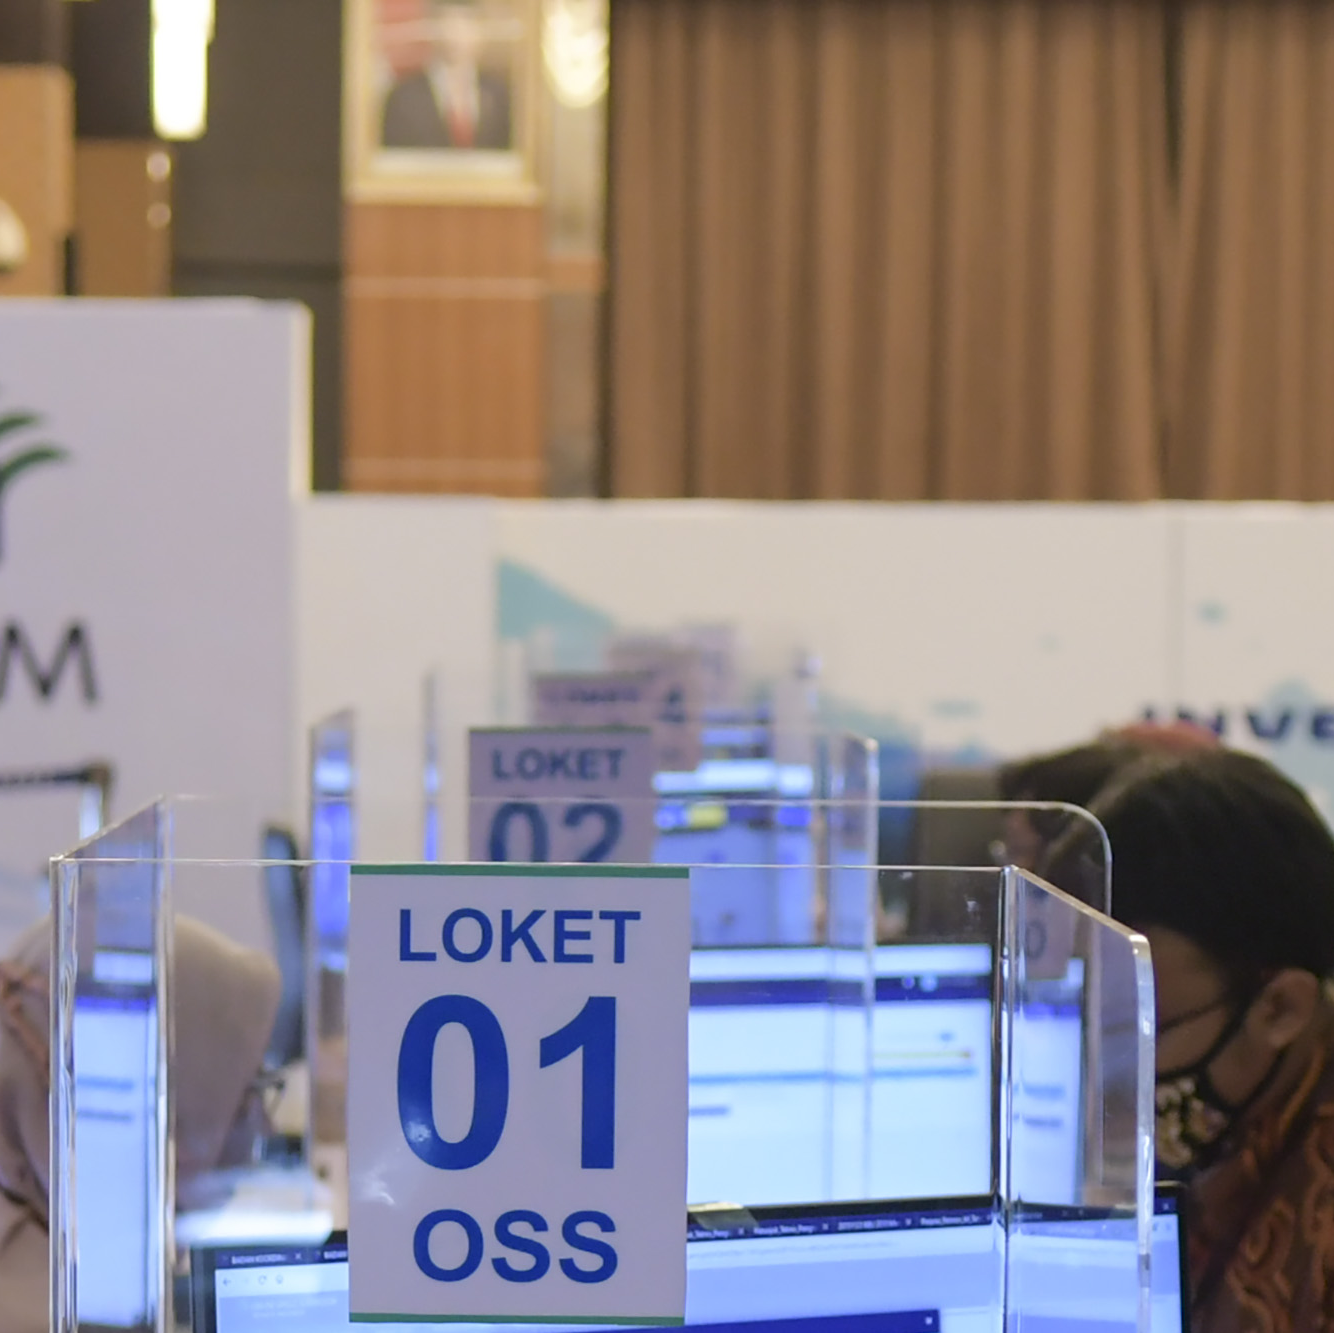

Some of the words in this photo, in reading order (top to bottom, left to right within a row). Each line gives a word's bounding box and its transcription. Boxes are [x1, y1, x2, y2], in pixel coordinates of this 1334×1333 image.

[493, 748, 626, 780] LOKET
[489, 801, 623, 862] 02
[399, 908, 641, 963] LOKET
[397, 994, 617, 1171] 01
[413, 1209, 619, 1283] OSS
